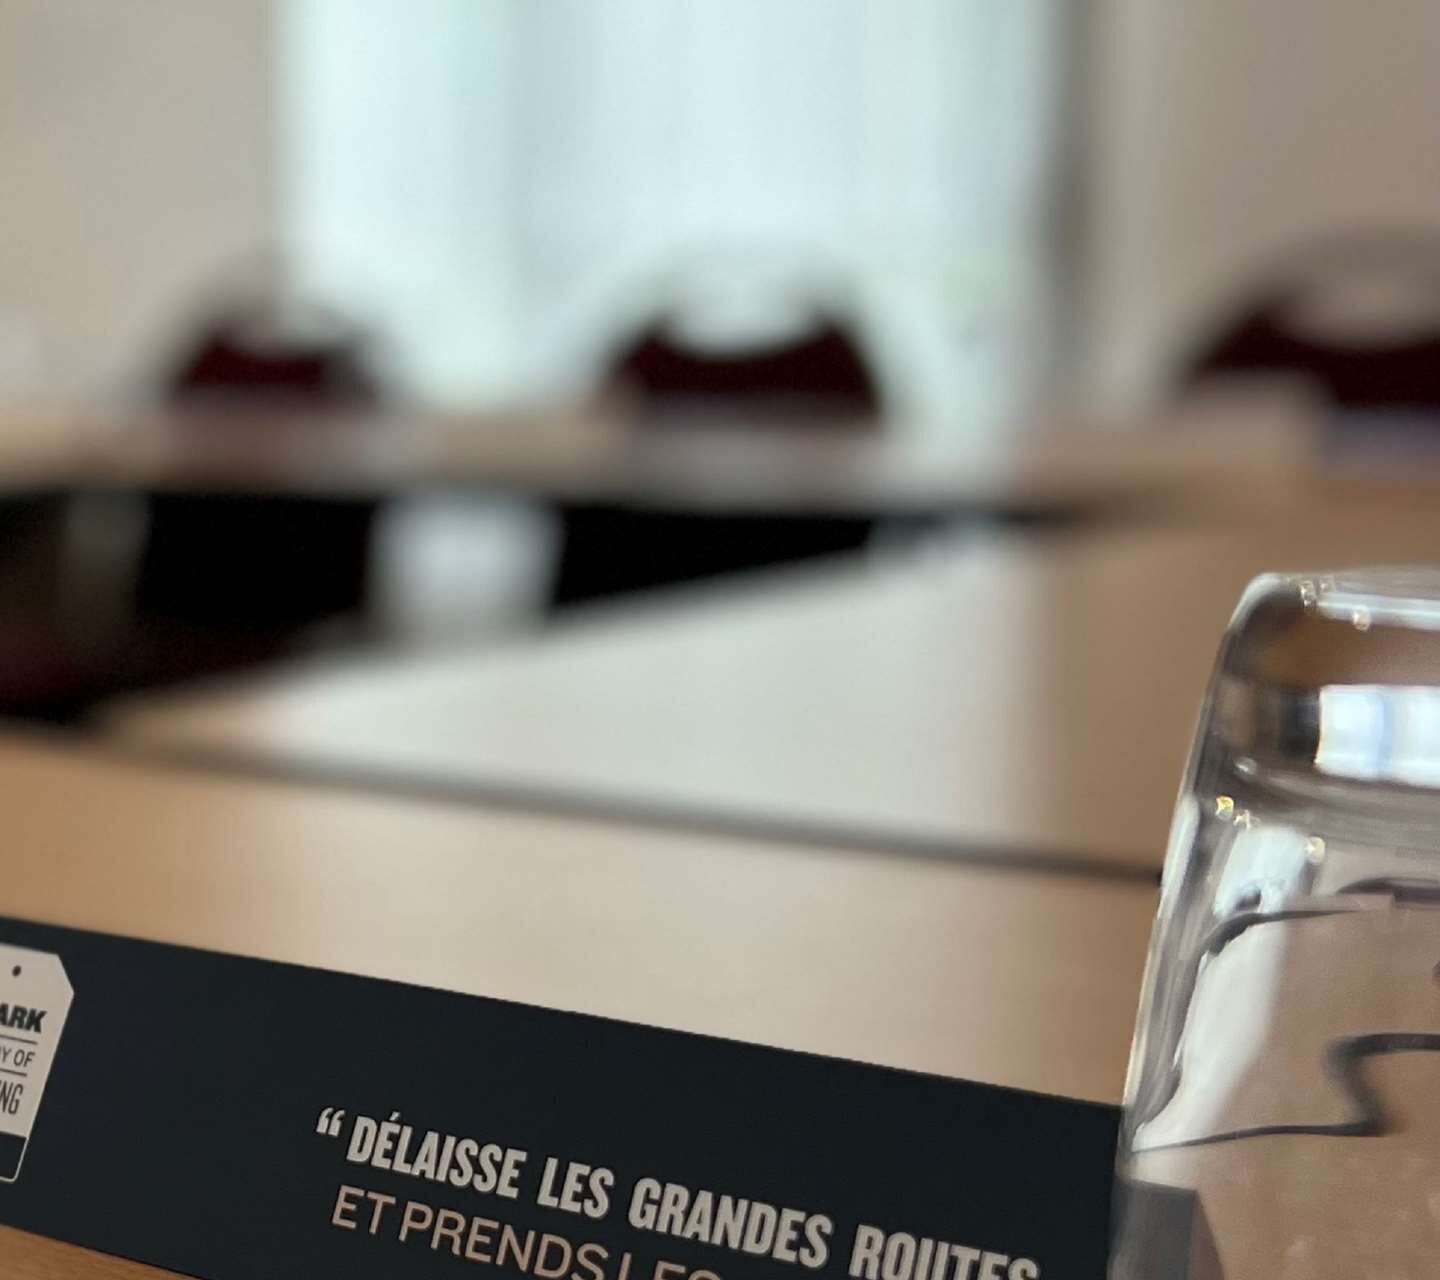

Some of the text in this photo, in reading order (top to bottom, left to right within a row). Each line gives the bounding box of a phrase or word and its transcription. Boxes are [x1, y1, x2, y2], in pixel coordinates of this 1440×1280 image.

[13, 1049, 36, 1068] OF
[332, 1184, 396, 1233] ET
[537, 1158, 615, 1220] LES
[628, 1177, 833, 1269] GRANDES
